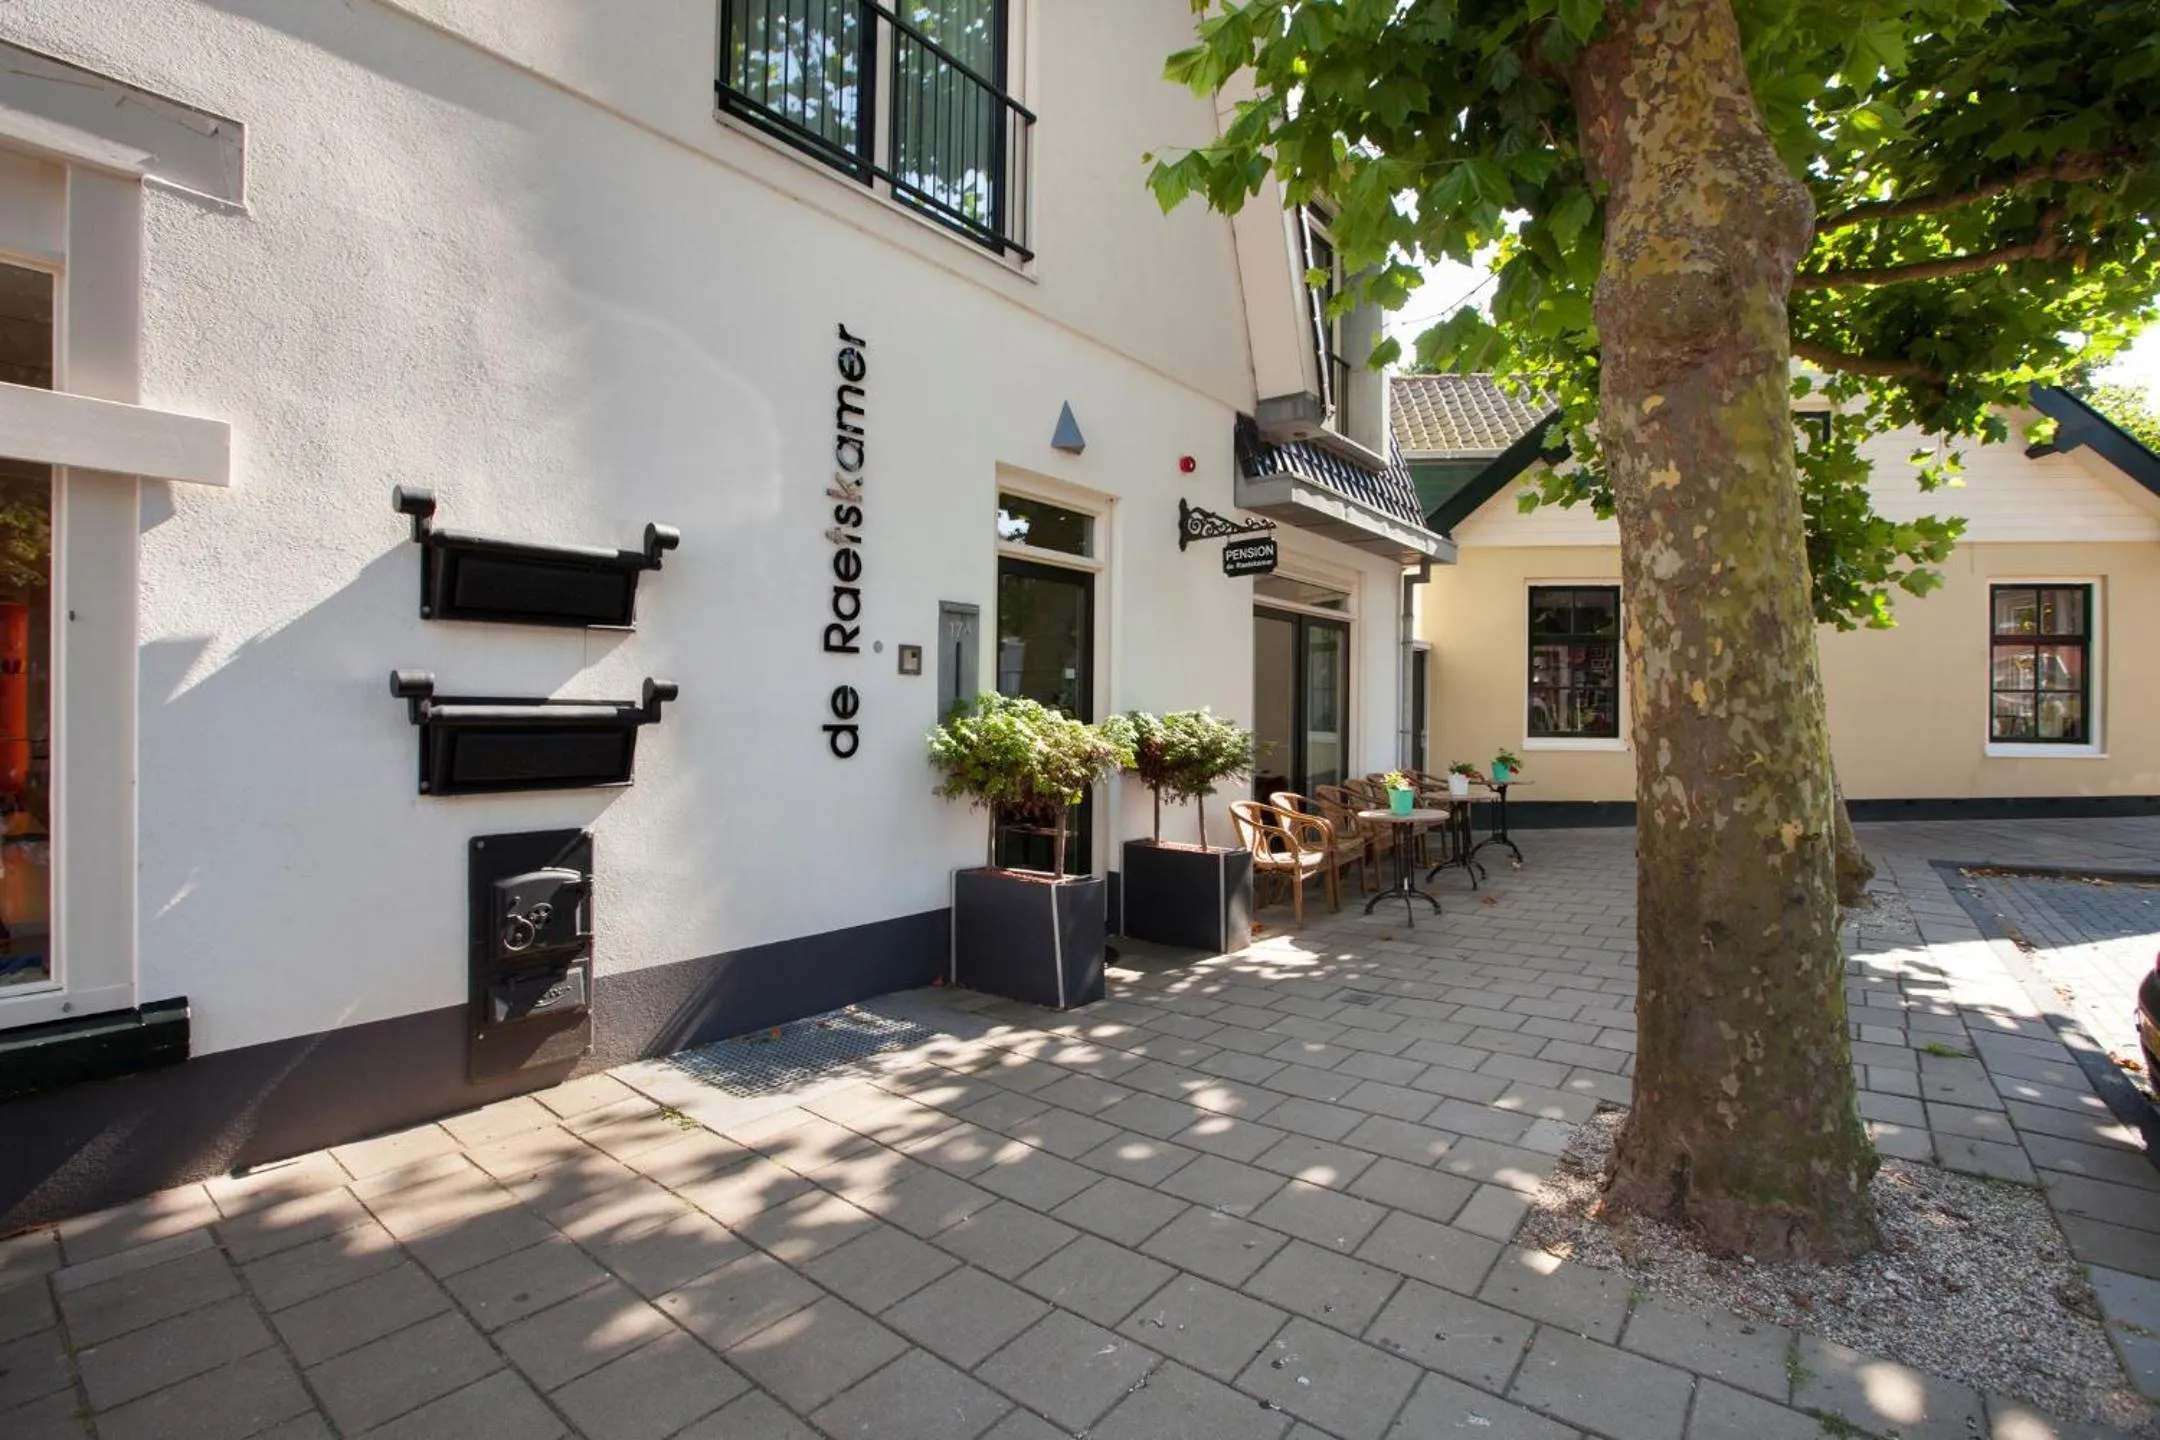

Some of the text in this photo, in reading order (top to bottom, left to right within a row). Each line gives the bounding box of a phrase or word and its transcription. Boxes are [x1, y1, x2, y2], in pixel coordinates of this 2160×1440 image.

[821, 323, 867, 759] de Raetskamer
[1225, 544, 1273, 560] PENSION
